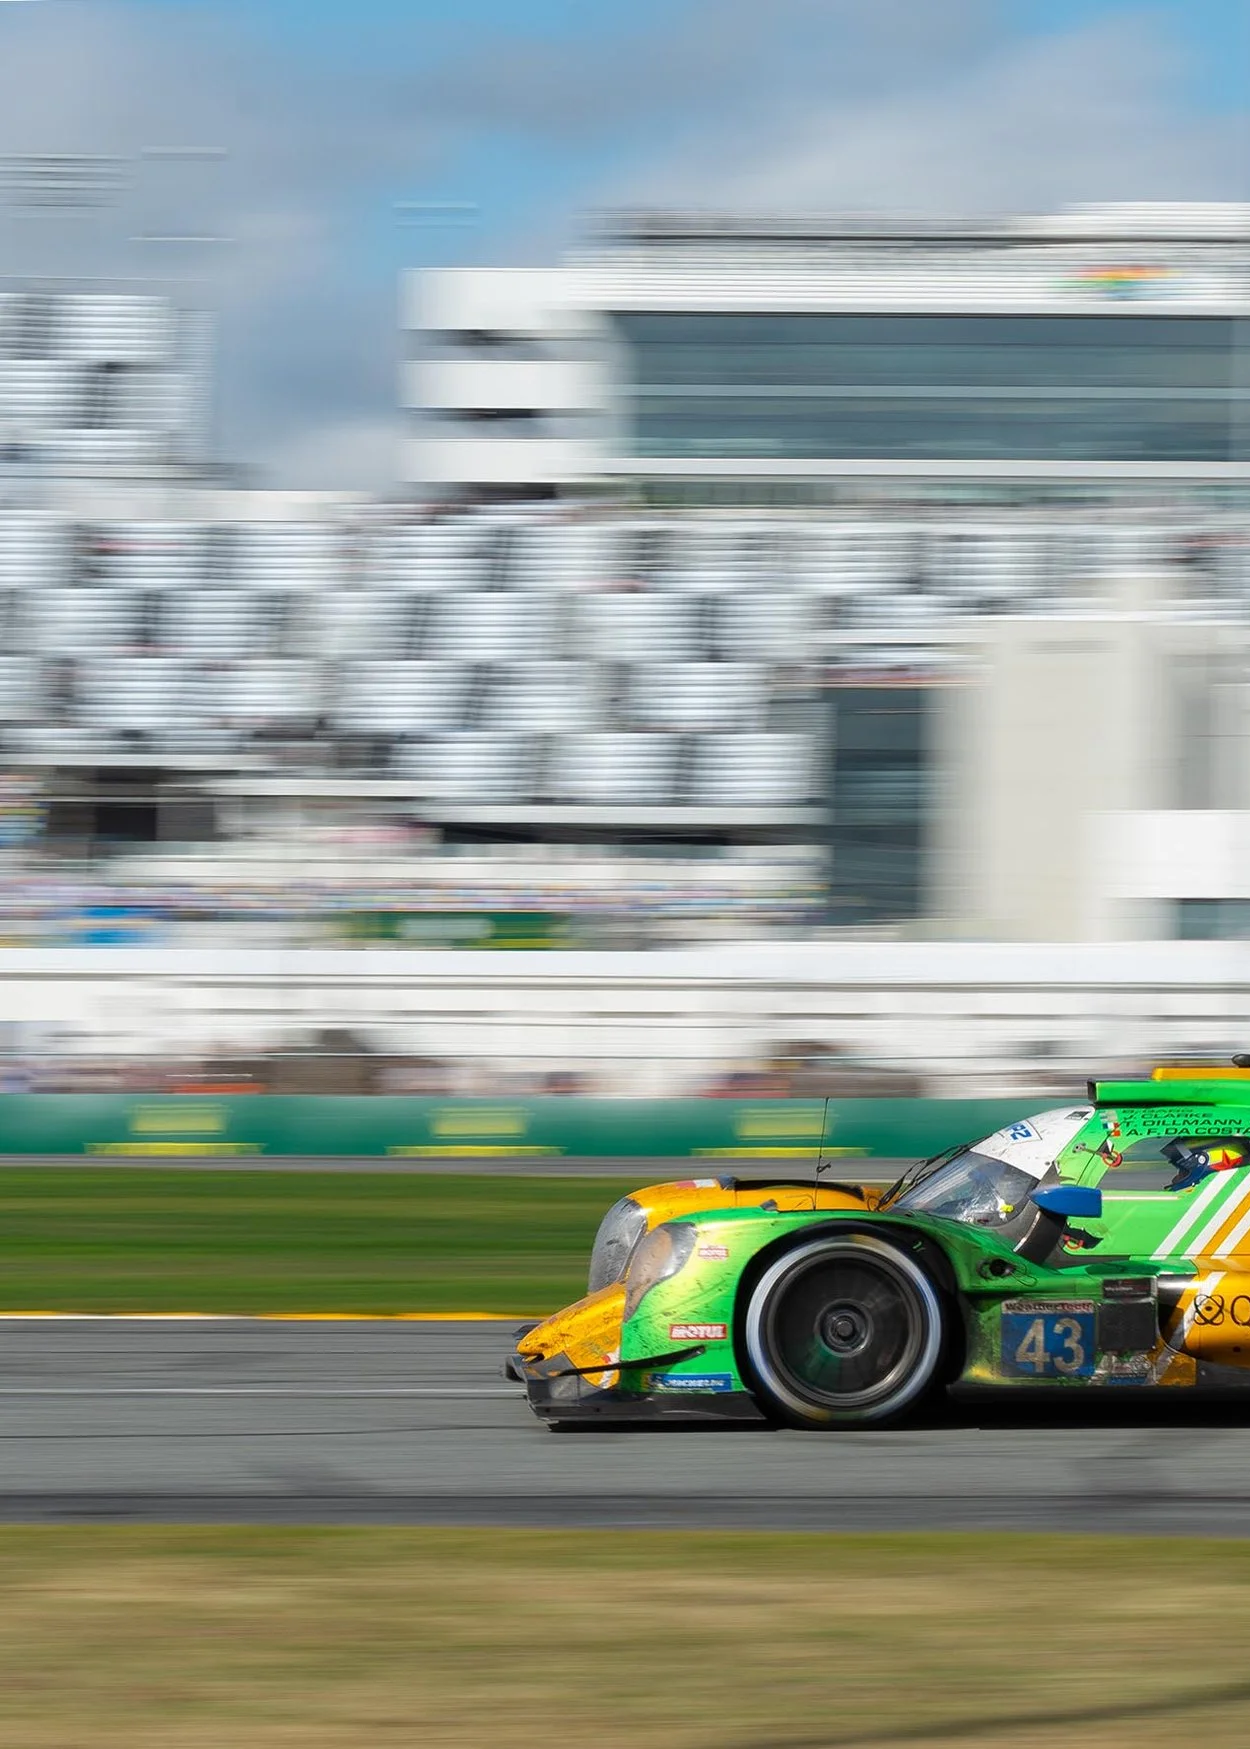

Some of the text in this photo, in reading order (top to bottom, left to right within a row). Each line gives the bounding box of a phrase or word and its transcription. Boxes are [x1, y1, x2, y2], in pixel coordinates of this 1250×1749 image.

[1122, 1119, 1243, 1128] T. DILLMANN
[1126, 1128, 1143, 1136] A.
[1147, 1128, 1161, 1136] F.
[1164, 1127, 1194, 1136] DA
[670, 1325, 725, 1339] MOTUL
[1015, 1317, 1085, 1374] 43
